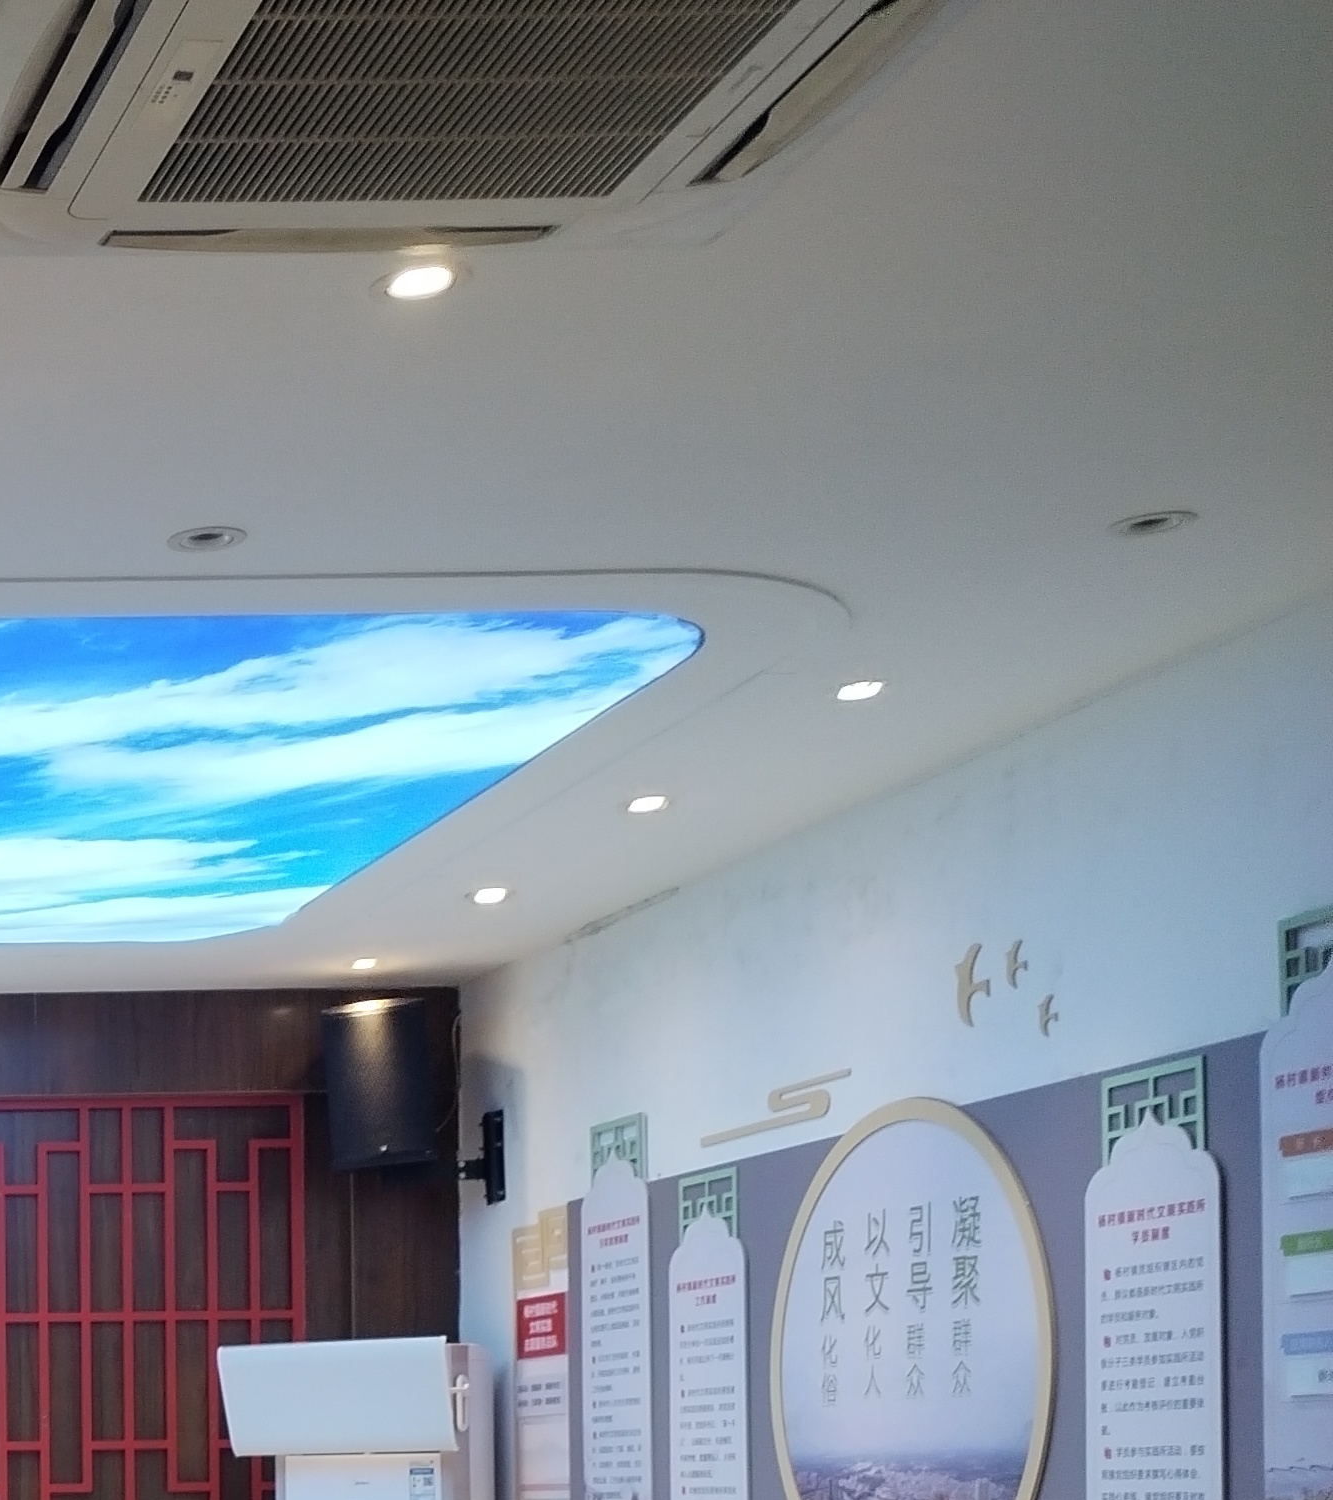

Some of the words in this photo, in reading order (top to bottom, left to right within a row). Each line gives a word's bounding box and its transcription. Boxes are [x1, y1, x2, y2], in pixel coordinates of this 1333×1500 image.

[821, 1219, 845, 1407] 成风化俗
[864, 1208, 890, 1398] 以文化人
[906, 1201, 933, 1397] 引导群众
[952, 1195, 982, 1394] 凝聚群众
